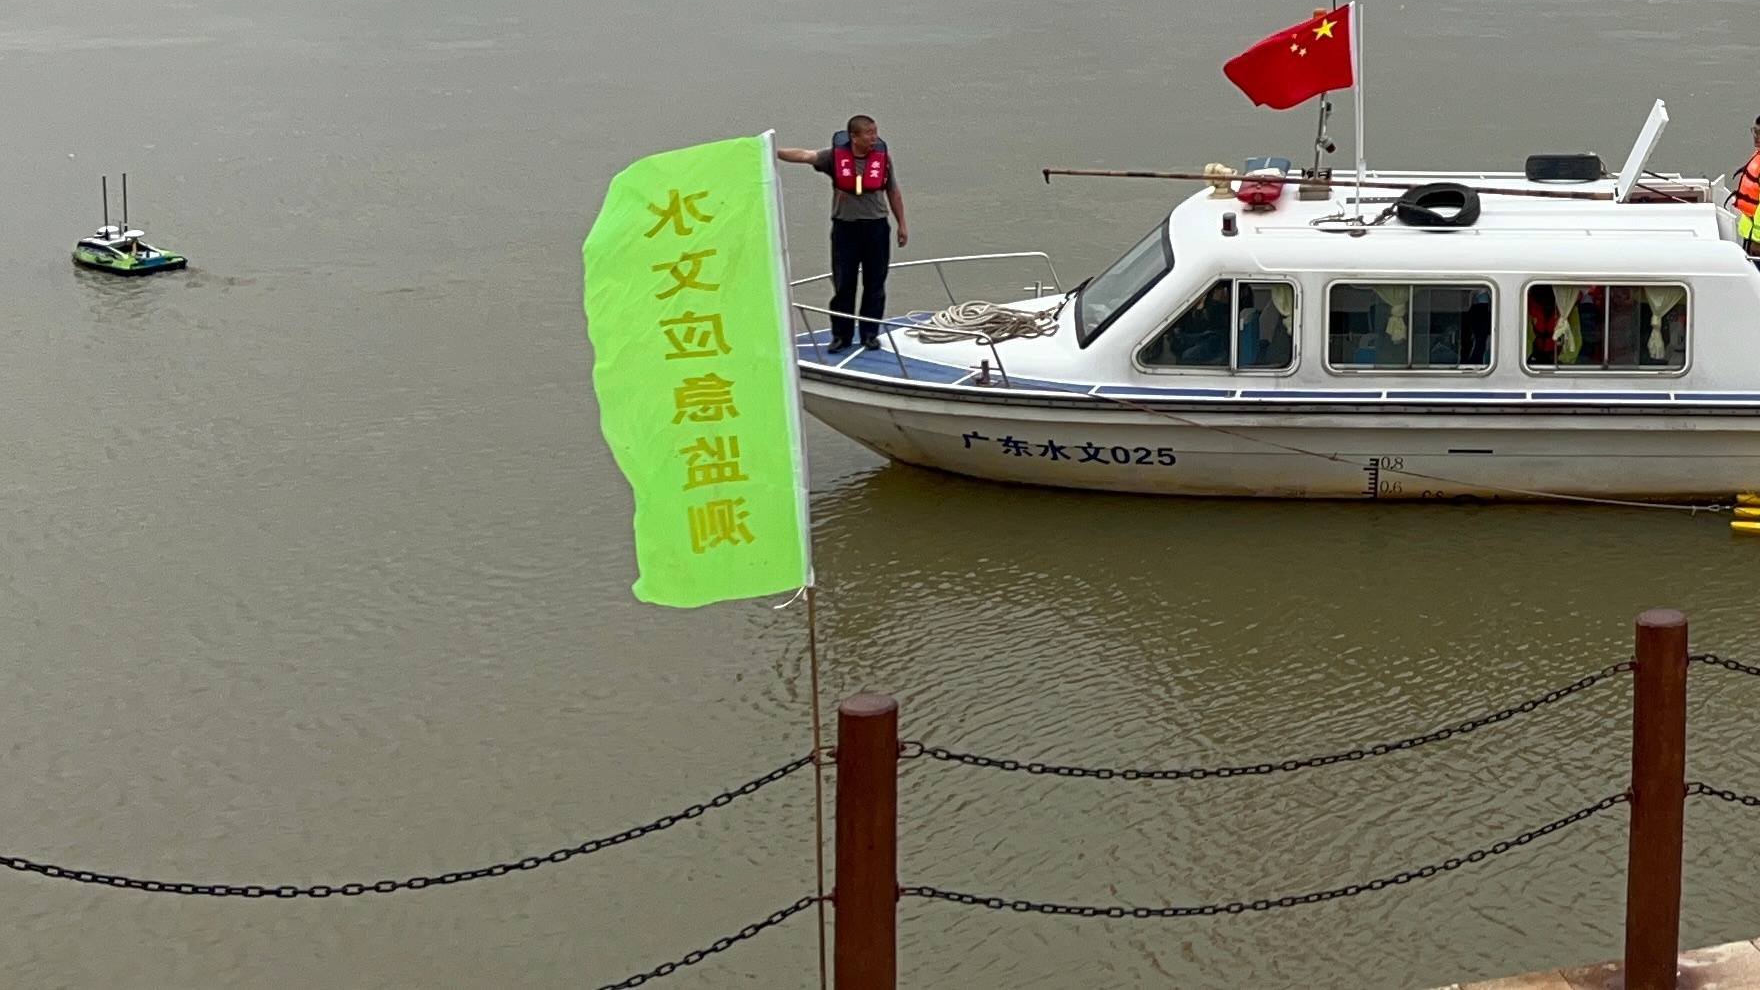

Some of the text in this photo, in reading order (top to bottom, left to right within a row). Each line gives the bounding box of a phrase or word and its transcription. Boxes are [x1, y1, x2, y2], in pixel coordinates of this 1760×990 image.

[962, 431, 1177, 466] 广东水文025
[1380, 456, 1404, 470] 0.8
[1379, 480, 1403, 494] 0.6
